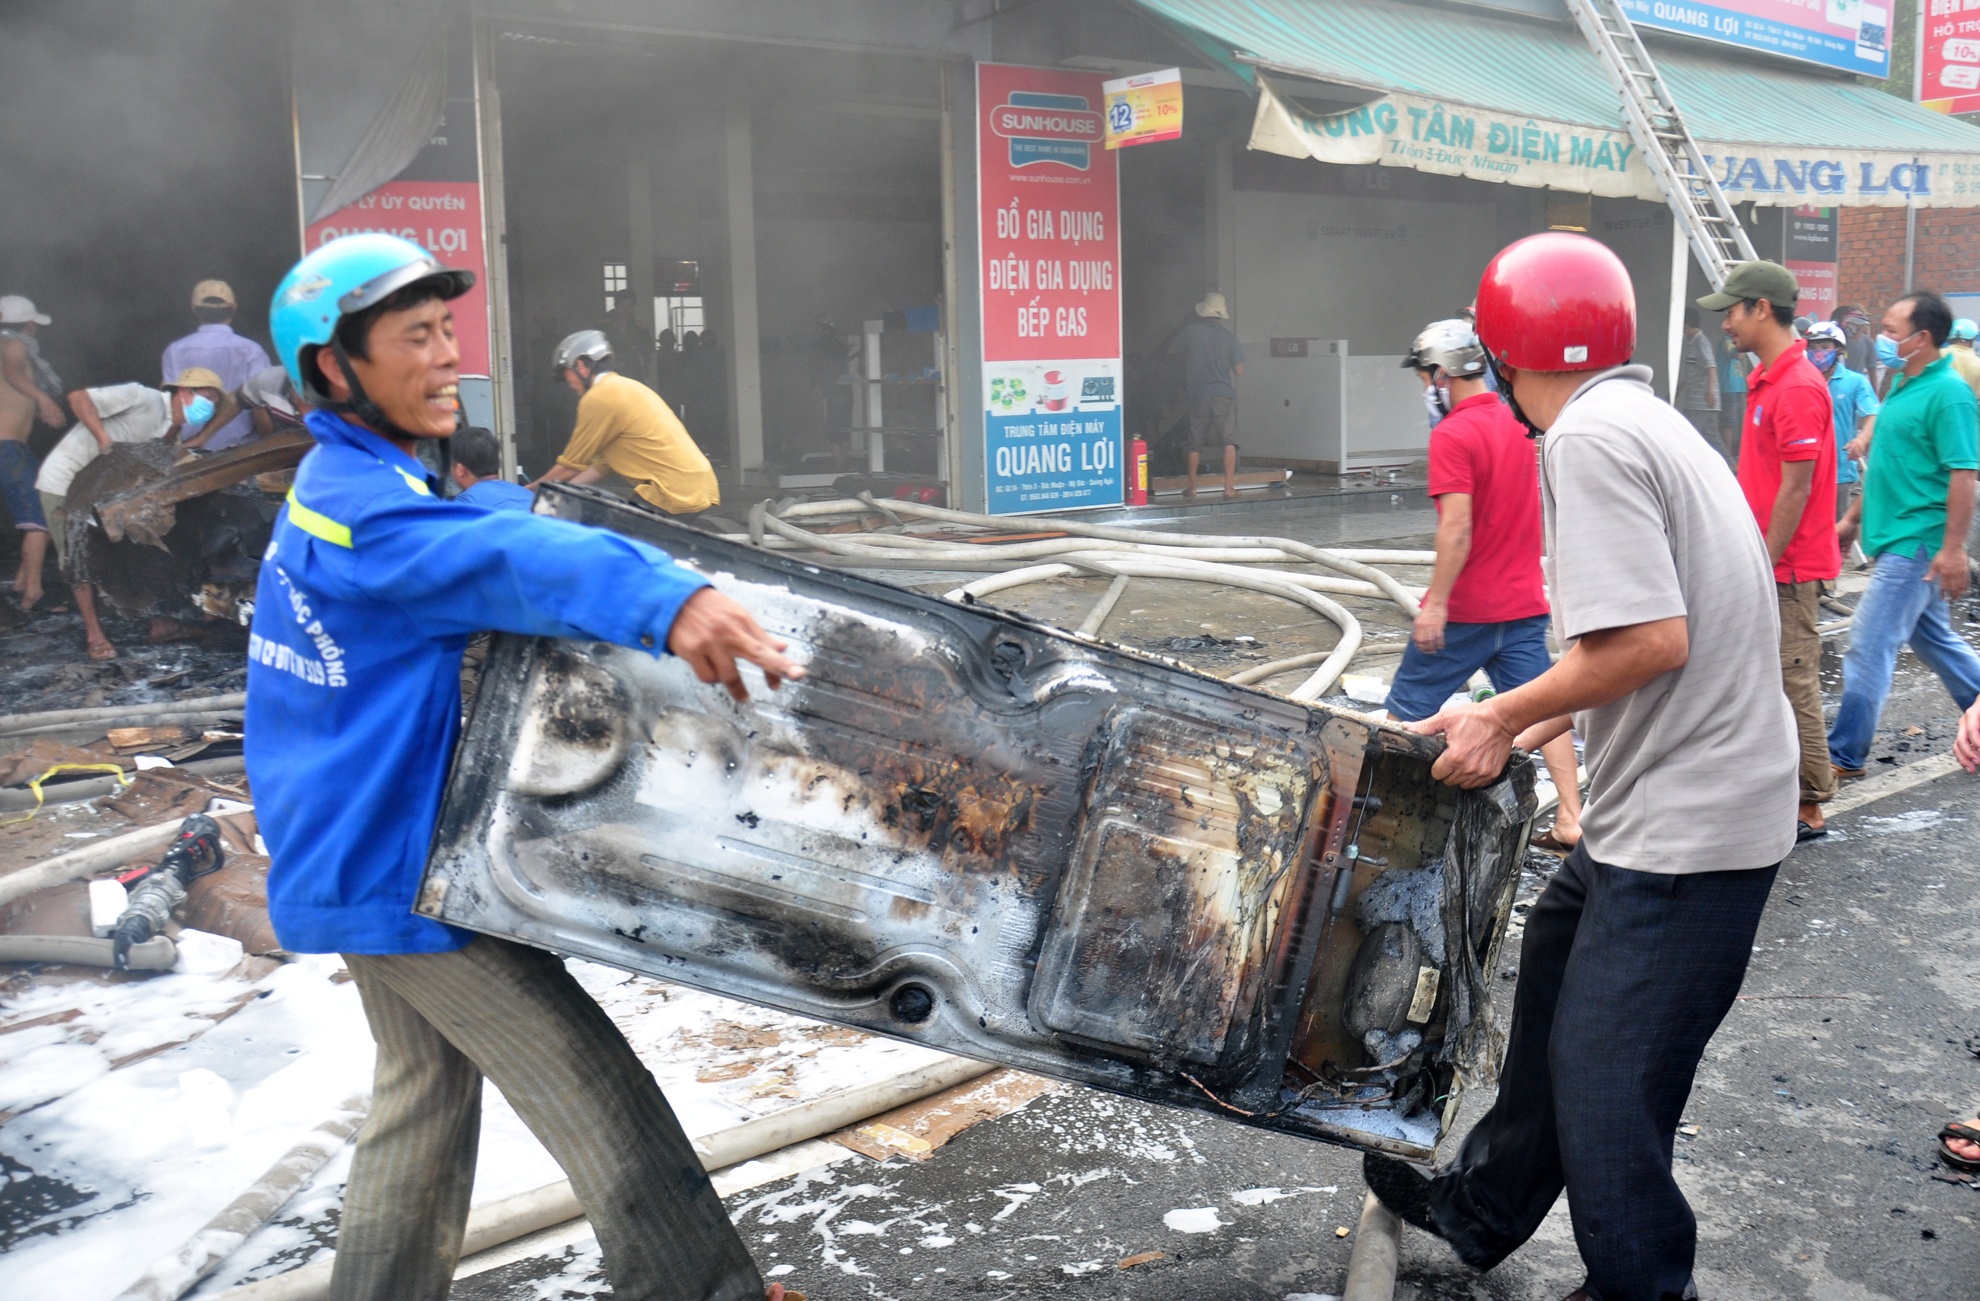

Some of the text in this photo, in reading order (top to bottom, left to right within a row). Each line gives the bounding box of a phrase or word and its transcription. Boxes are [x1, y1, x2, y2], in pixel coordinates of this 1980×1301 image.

[1653, 2, 1709, 28] QUANG
[1714, 15, 1739, 36] LỢI
[1953, 45, 1977, 59] 10%
[1002, 113, 1096, 134] SUNHOUSE
[1110, 103, 1131, 128] 12
[1157, 104, 1178, 117] 10%
[1291, 102, 1635, 173] RUNG TÂM ĐIỆN MÁY
[1008, 174, 1091, 185] www.sunhouse.com.vn
[1366, 170, 1391, 190] LG
[1687, 154, 1848, 195] UANG
[996, 196, 1104, 246] ĐỒ GIA DỤNG
[426, 228, 468, 257] LỢI
[989, 252, 1113, 296] ĐIỆN GIA DỤNG
[1018, 295, 1087, 337] BẾP GAS
[1287, 343, 1299, 352] LG
[1004, 419, 1105, 438] TRUNG TÂM ĐIỆN MÁY
[996, 437, 1114, 477] QUANG LỢI
